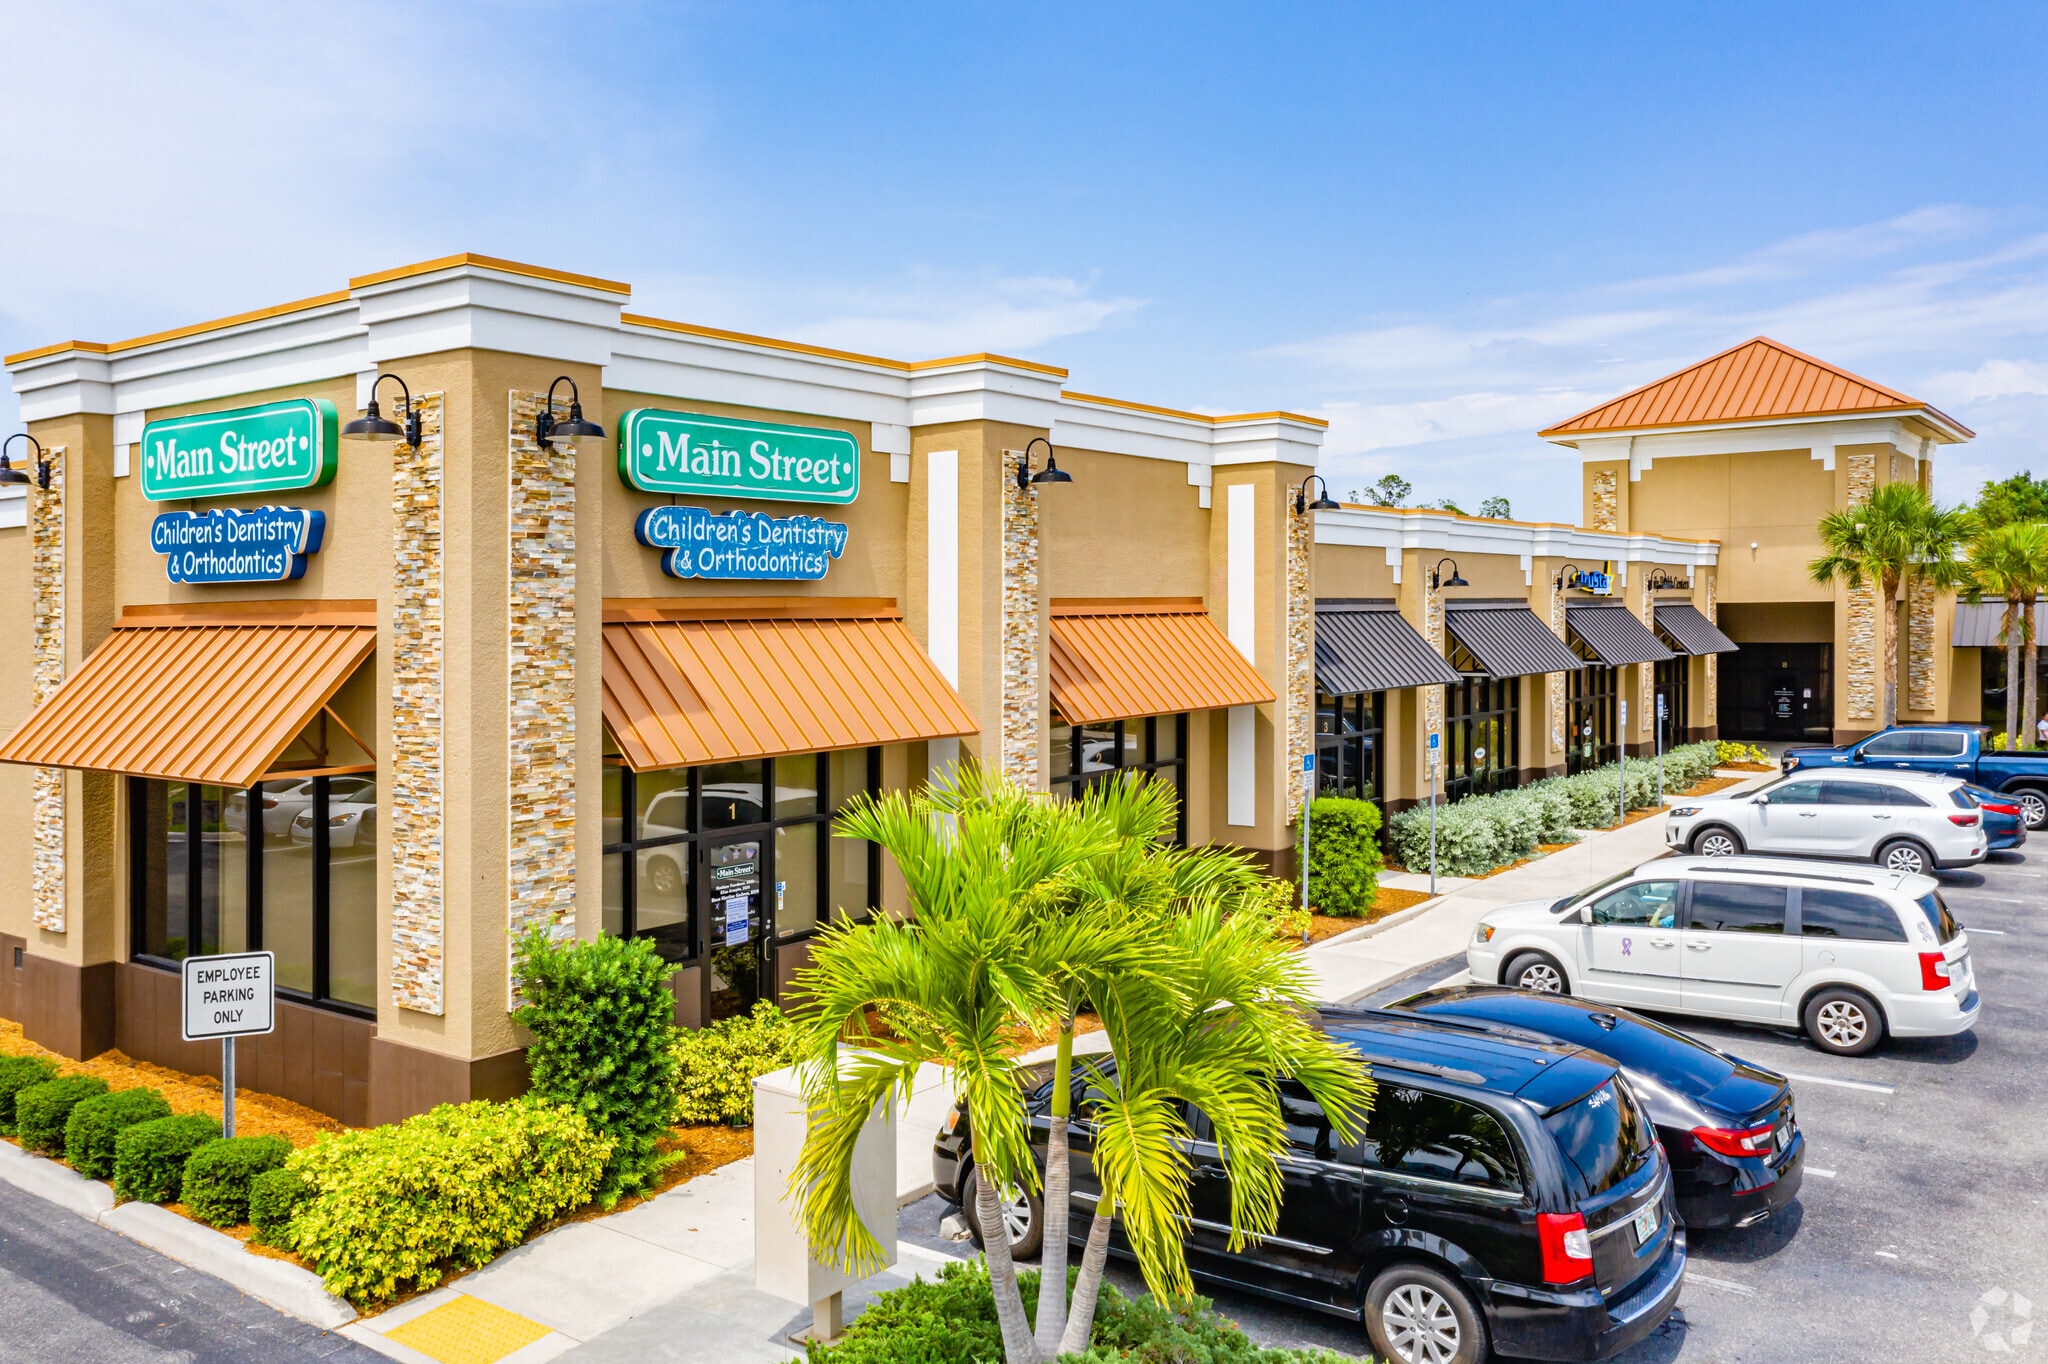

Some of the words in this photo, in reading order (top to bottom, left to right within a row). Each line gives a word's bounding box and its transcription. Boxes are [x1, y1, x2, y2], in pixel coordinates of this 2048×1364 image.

[155, 438, 214, 481] Main
[219, 427, 297, 474] Street
[656, 431, 742, 478] Main
[749, 440, 841, 485] Street
[154, 518, 222, 546] Children's
[227, 515, 302, 548] Dentistry
[653, 515, 751, 544] Children's
[758, 519, 844, 552] Dentistry
[170, 554, 180, 575] &
[183, 548, 283, 576] Orthodontics
[680, 550, 692, 570] &
[698, 547, 823, 573] Orthodontics
[1323, 721, 1329, 733] 3
[728, 803, 736, 820] 1
[720, 869, 734, 878] Main
[734, 866, 751, 875] Street
[197, 966, 261, 984] EMPLOYEE
[203, 987, 254, 1004] PARKING
[213, 1009, 244, 1024] ONLY
